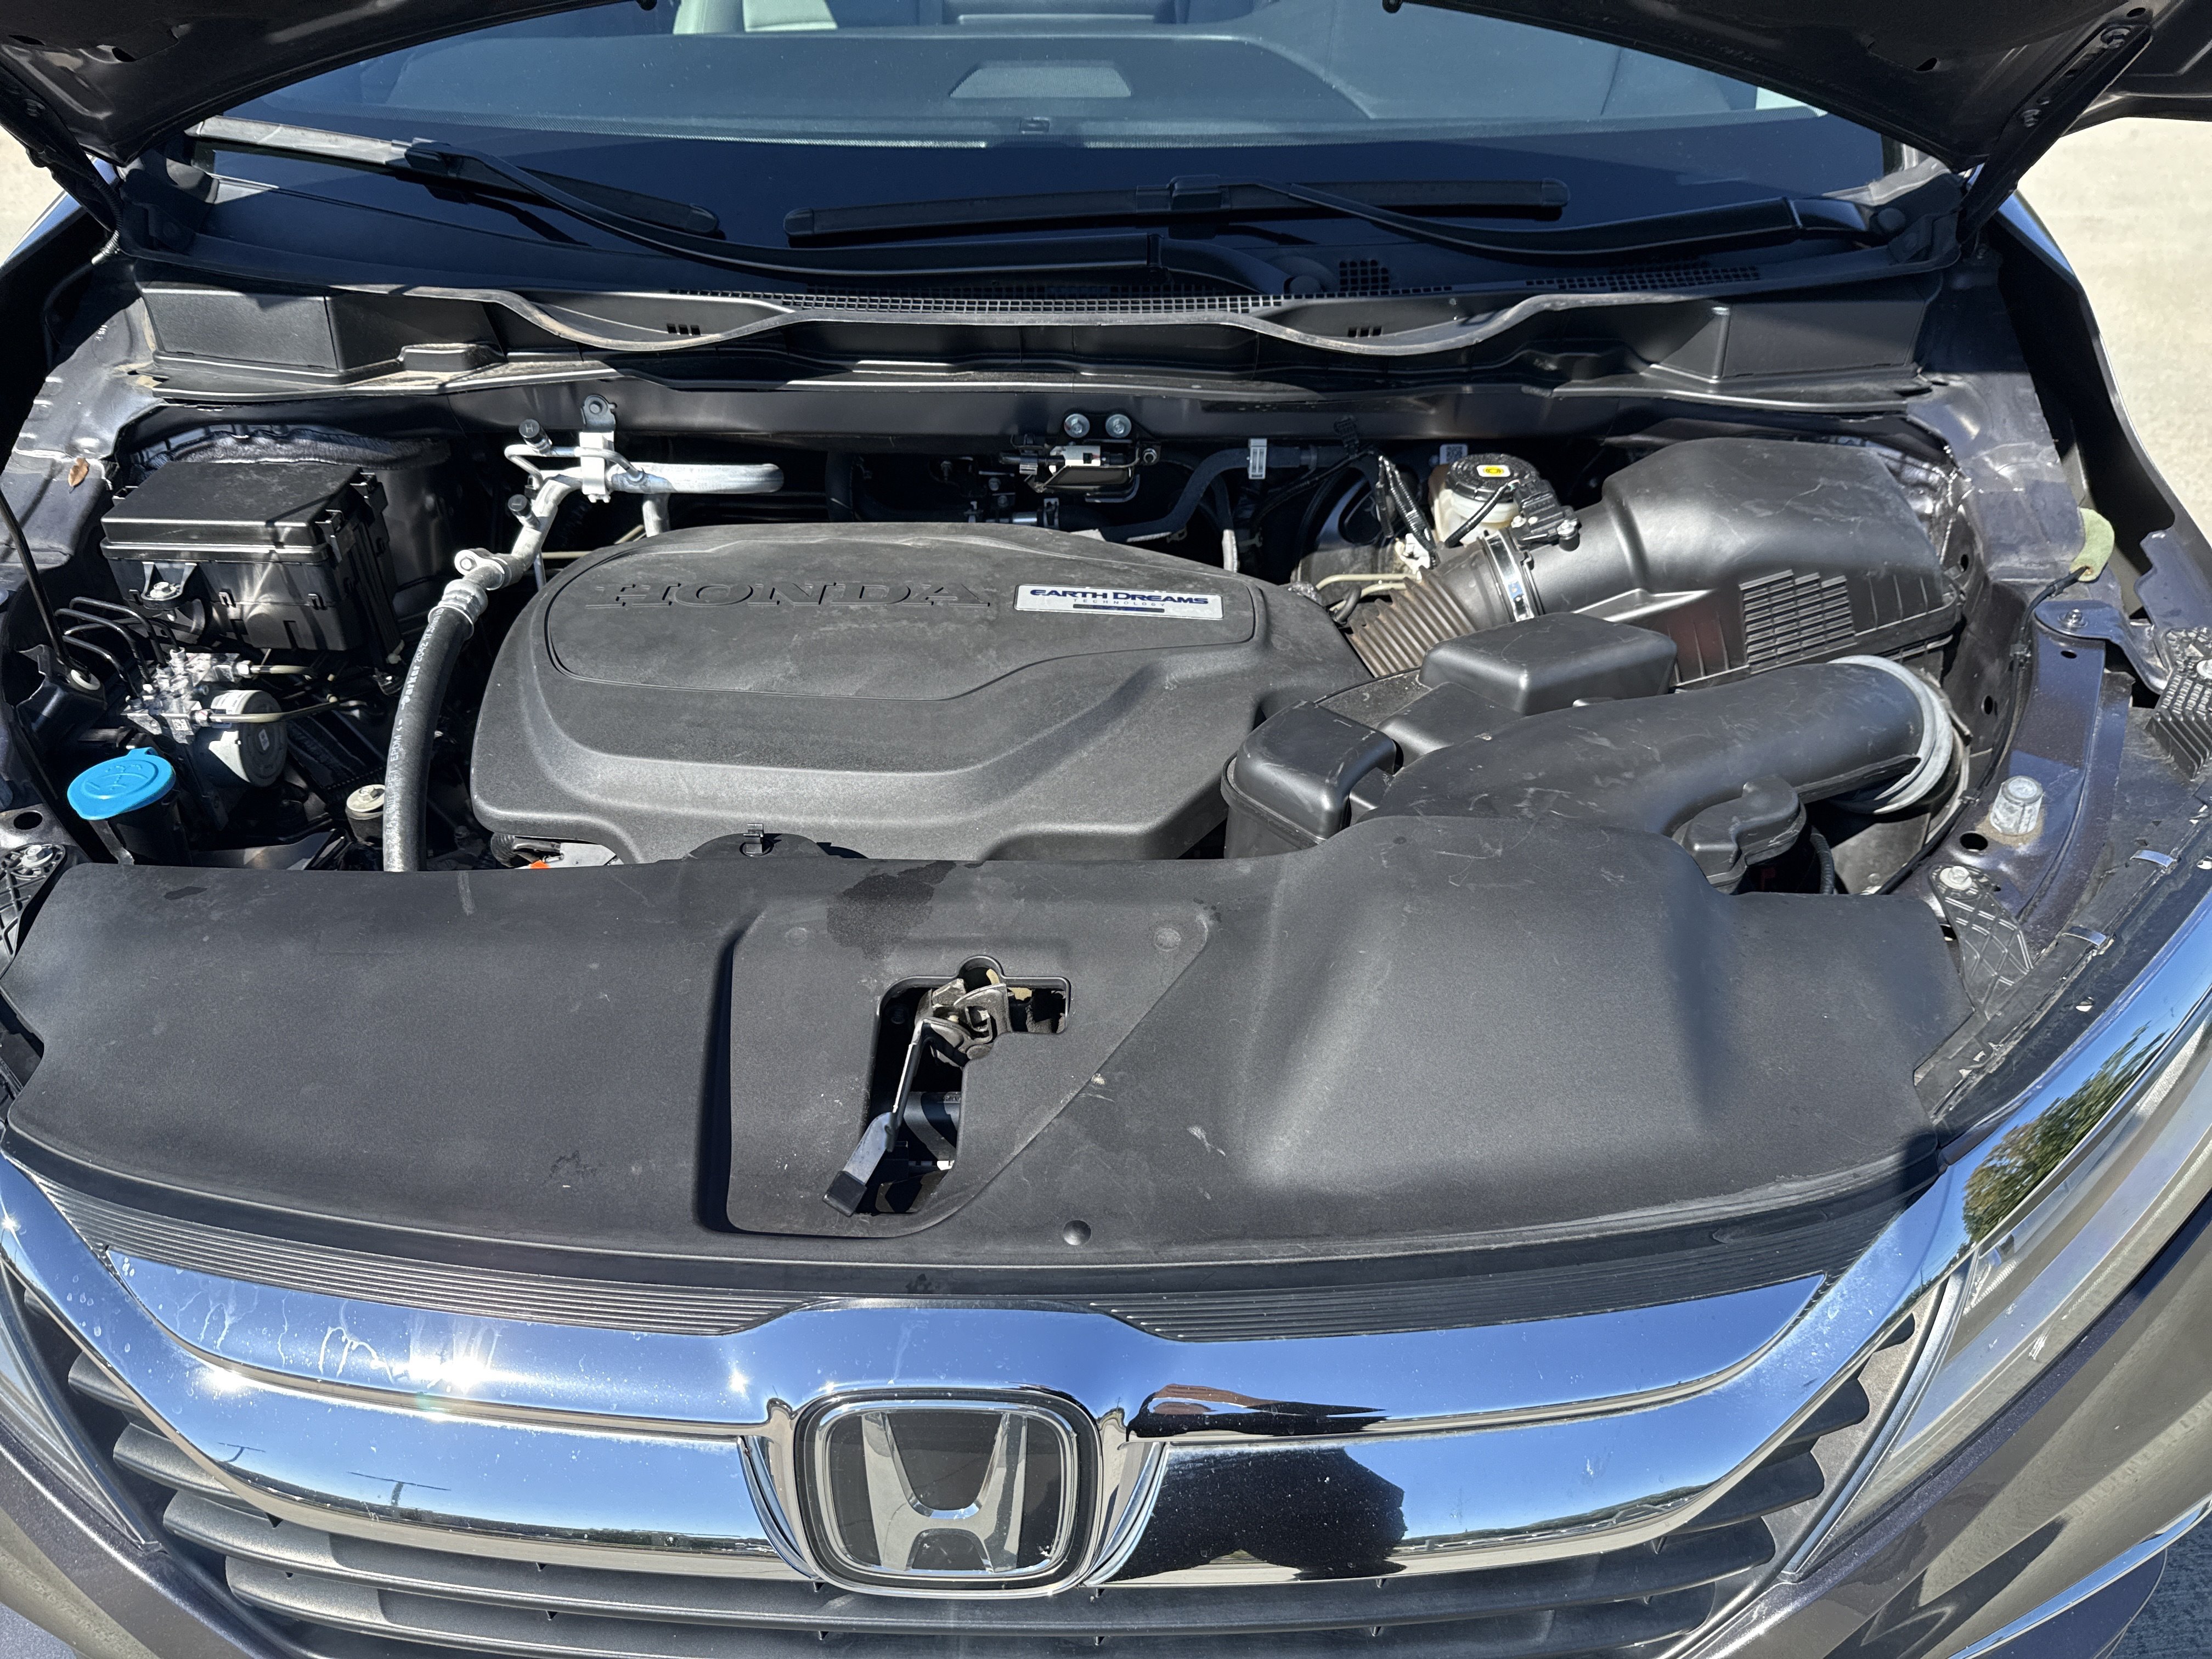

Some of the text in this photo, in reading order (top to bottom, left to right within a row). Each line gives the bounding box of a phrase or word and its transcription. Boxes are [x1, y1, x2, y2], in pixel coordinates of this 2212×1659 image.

[524, 423, 534, 433] H
[586, 582, 990, 608] HONDA
[1030, 589, 1209, 605] EARTH DREAMS
[1073, 598, 1166, 607] TECHNOLOGY
